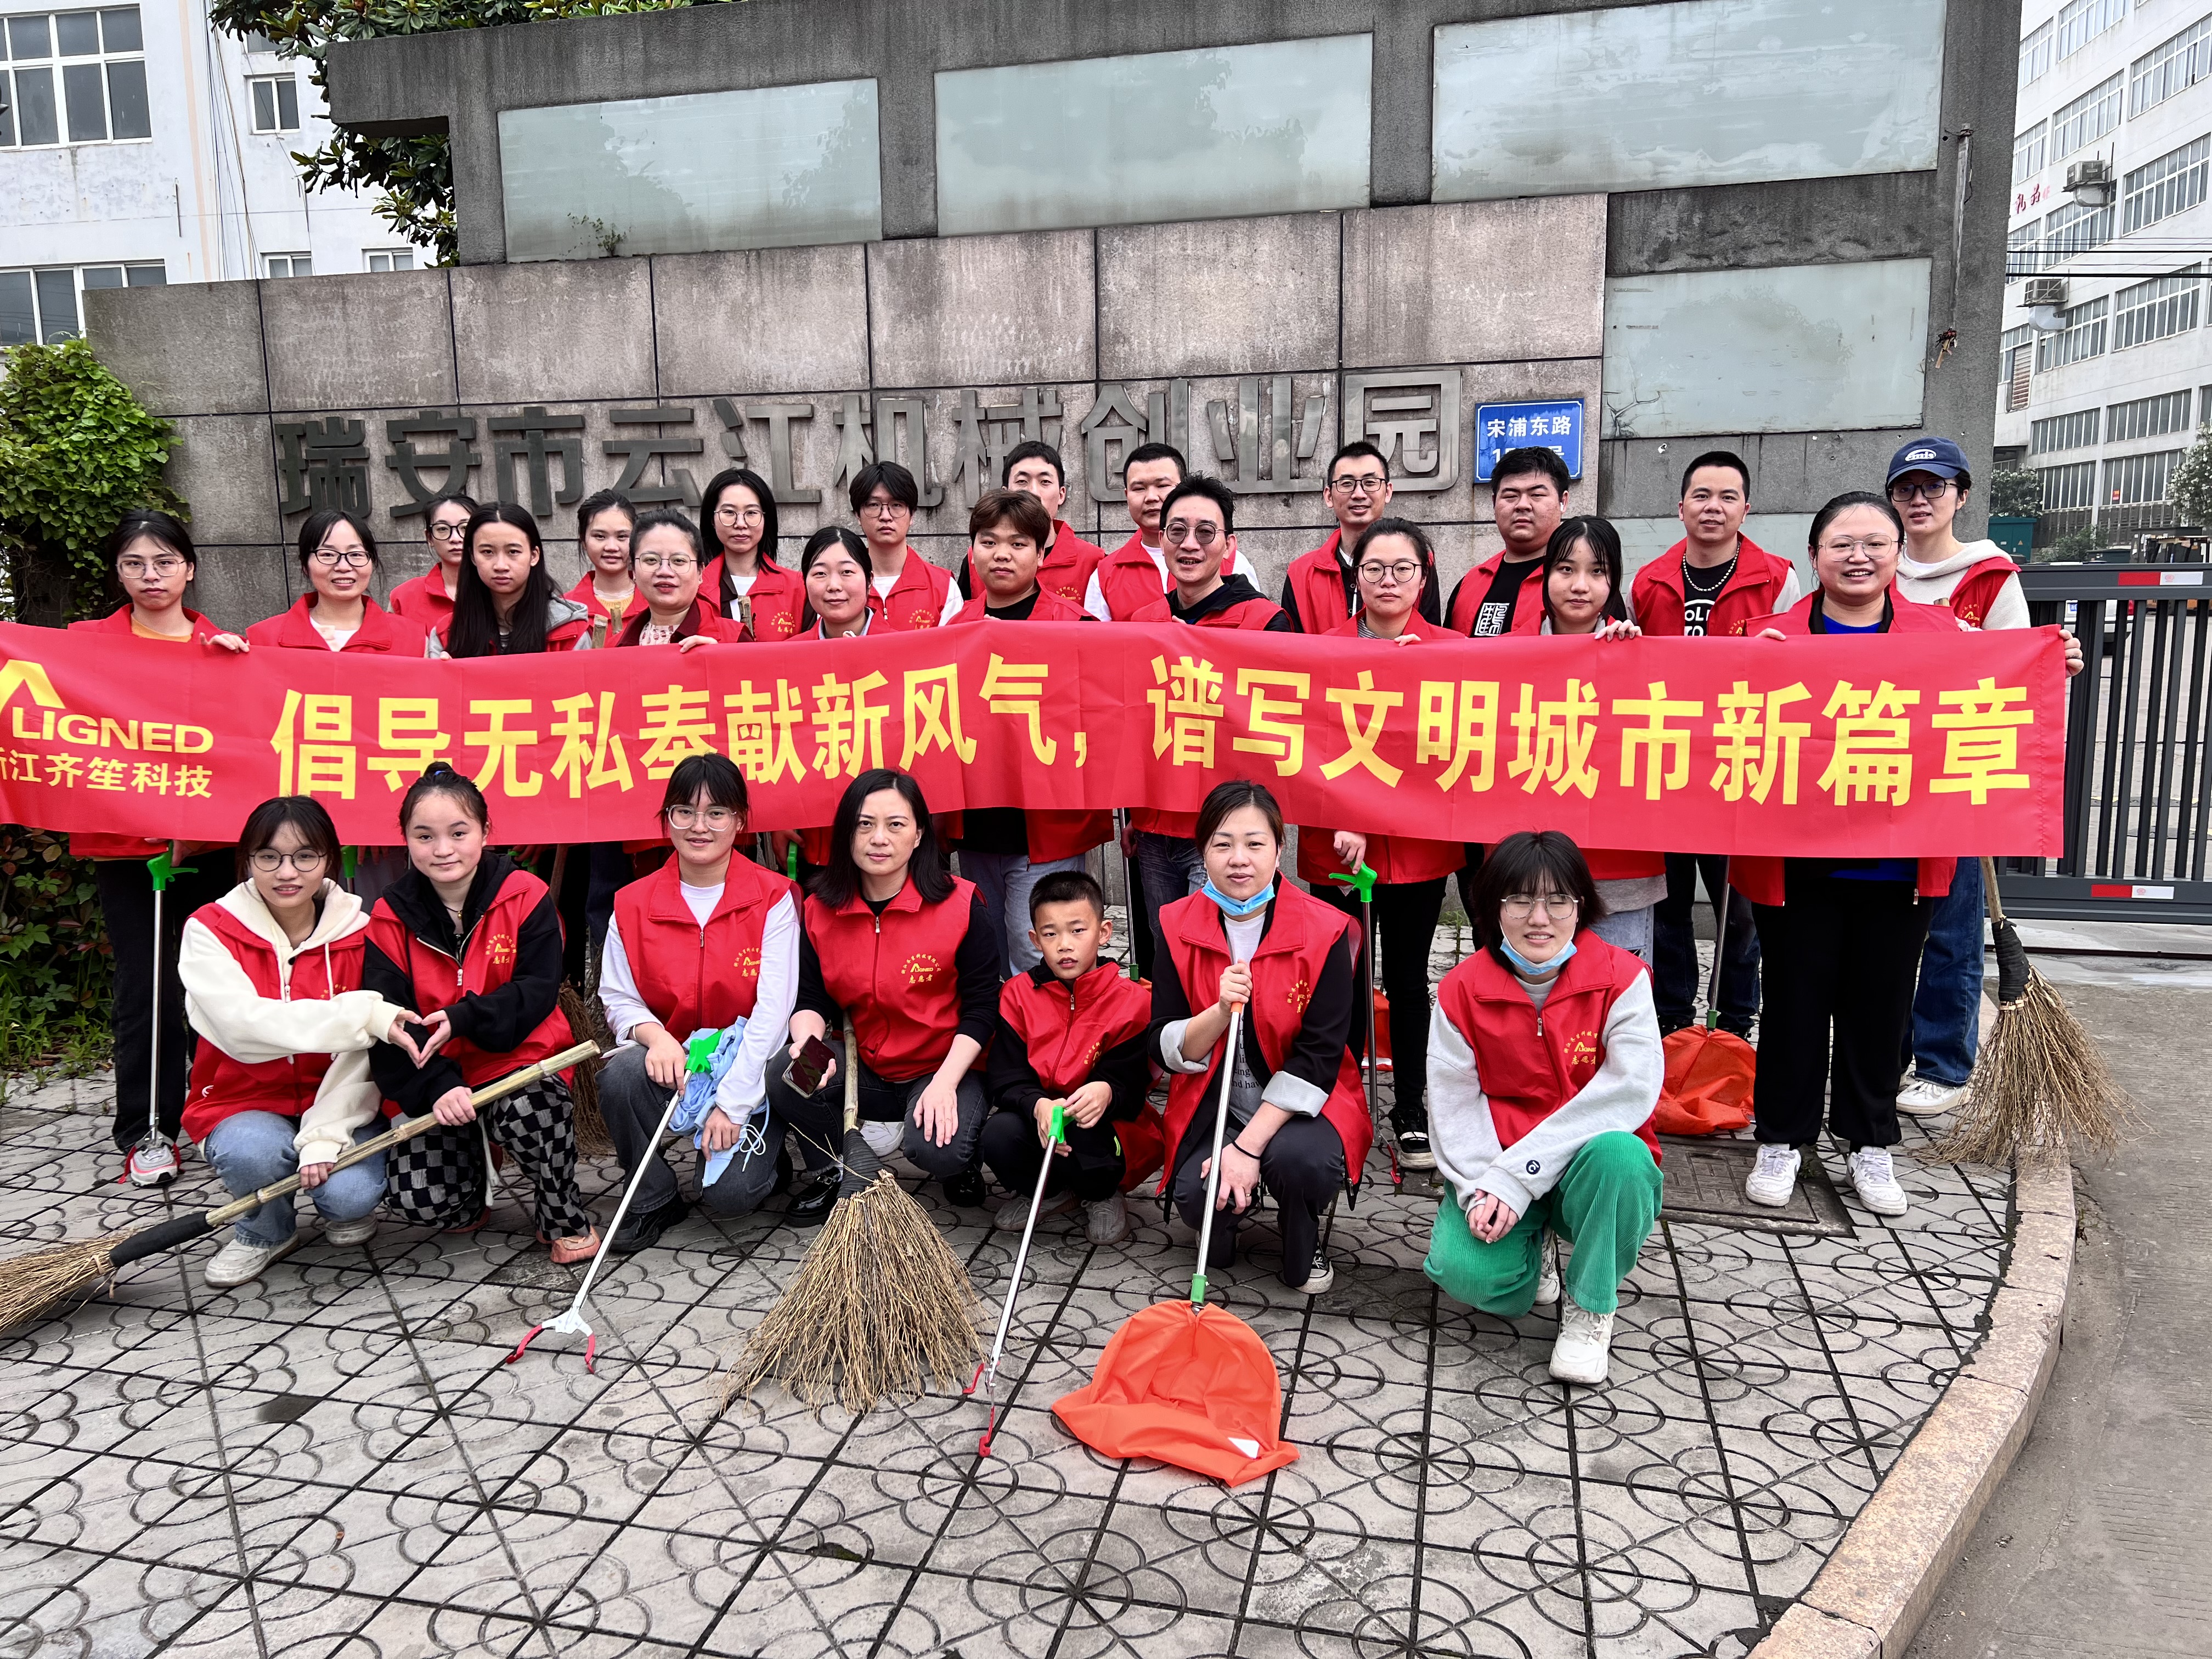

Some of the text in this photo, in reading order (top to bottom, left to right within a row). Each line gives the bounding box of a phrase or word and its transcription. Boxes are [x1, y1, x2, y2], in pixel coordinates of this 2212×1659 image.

[1487, 415, 1572, 438] 宋浦东路
[0, 747, 213, 798] 江齐笙科技
[1574, 1041, 1596, 1052] ALIGNE
